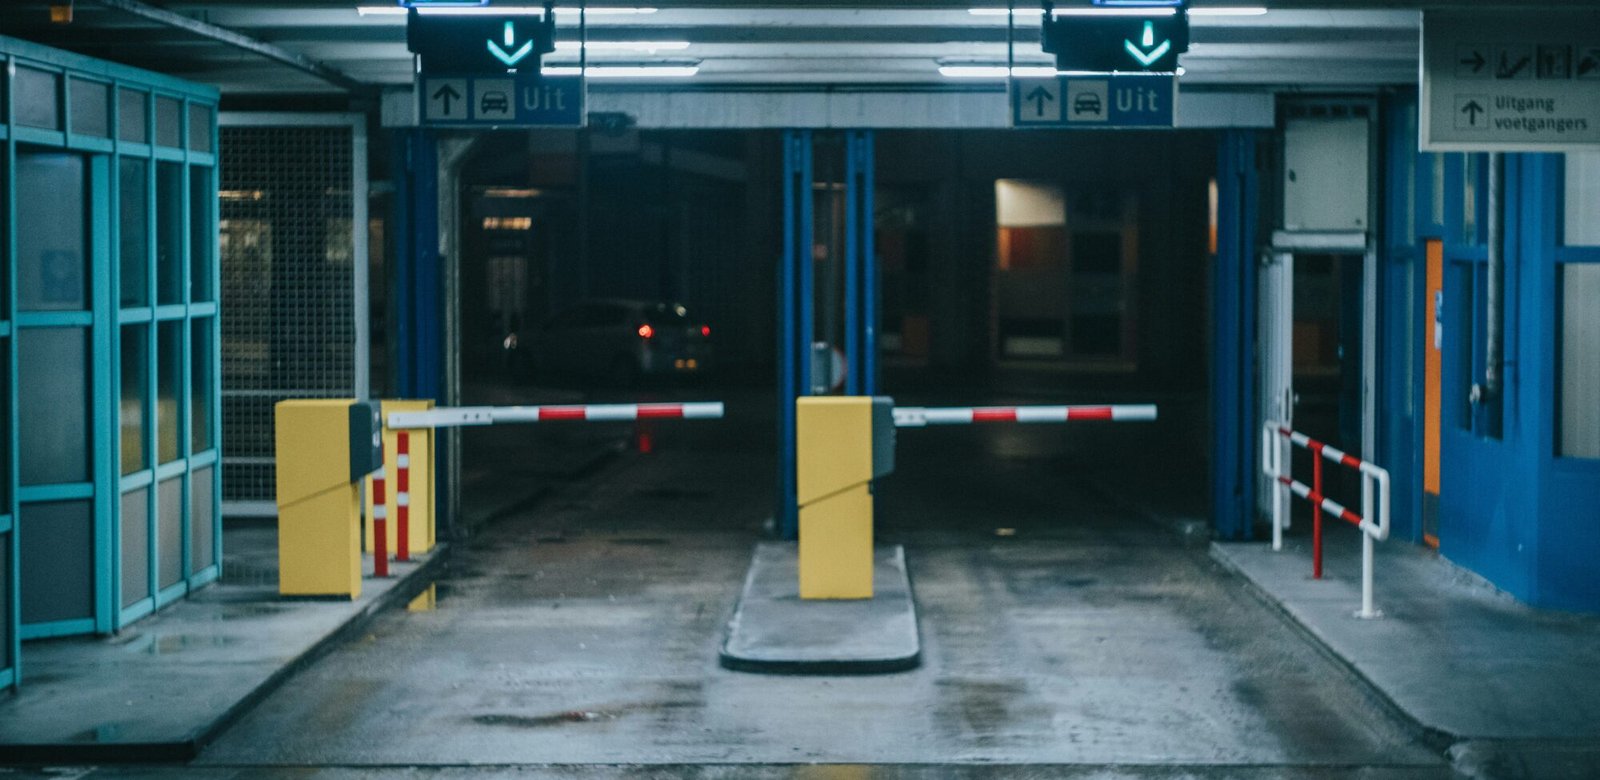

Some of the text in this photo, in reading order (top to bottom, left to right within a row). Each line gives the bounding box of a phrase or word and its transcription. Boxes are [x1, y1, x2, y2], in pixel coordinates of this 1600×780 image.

[524, 85, 565, 110] Uit
[1116, 87, 1158, 112] Uit
[1495, 95, 1555, 112] Uitgang
[1495, 117, 1588, 133] voetgangers
